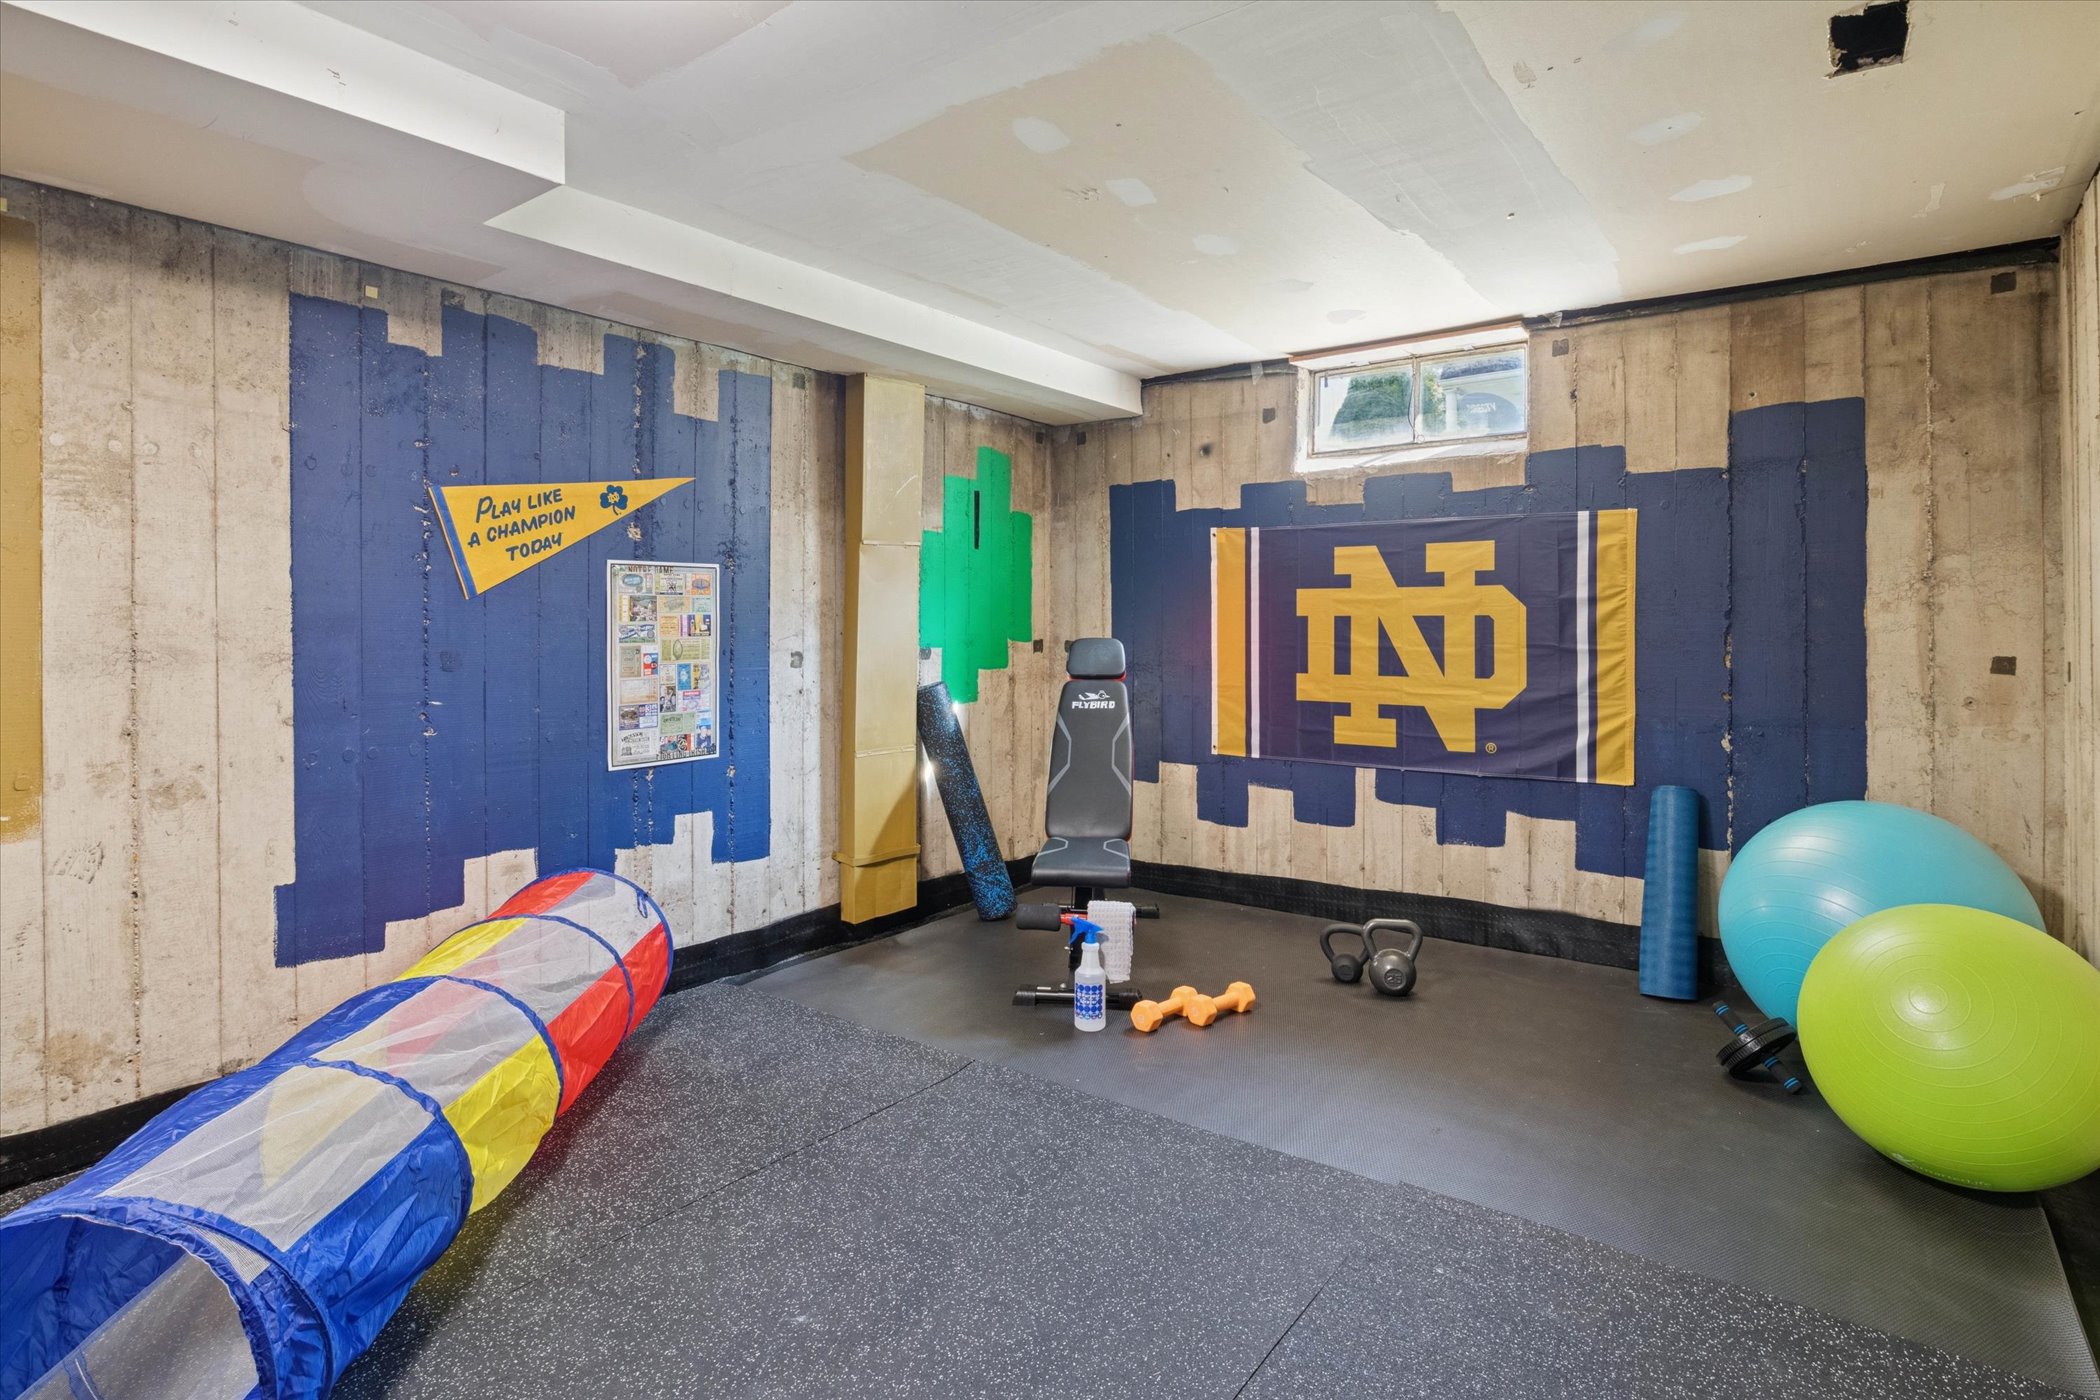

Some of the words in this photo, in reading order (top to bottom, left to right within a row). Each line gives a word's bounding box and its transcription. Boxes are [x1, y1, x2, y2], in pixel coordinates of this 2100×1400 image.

[475, 496, 521, 523] PLAY
[527, 488, 563, 510] LIKE
[467, 531, 481, 548] A
[486, 505, 576, 542] CHAMPION
[505, 532, 562, 561] TODAY
[1071, 700, 1116, 709] FLYBIRD
